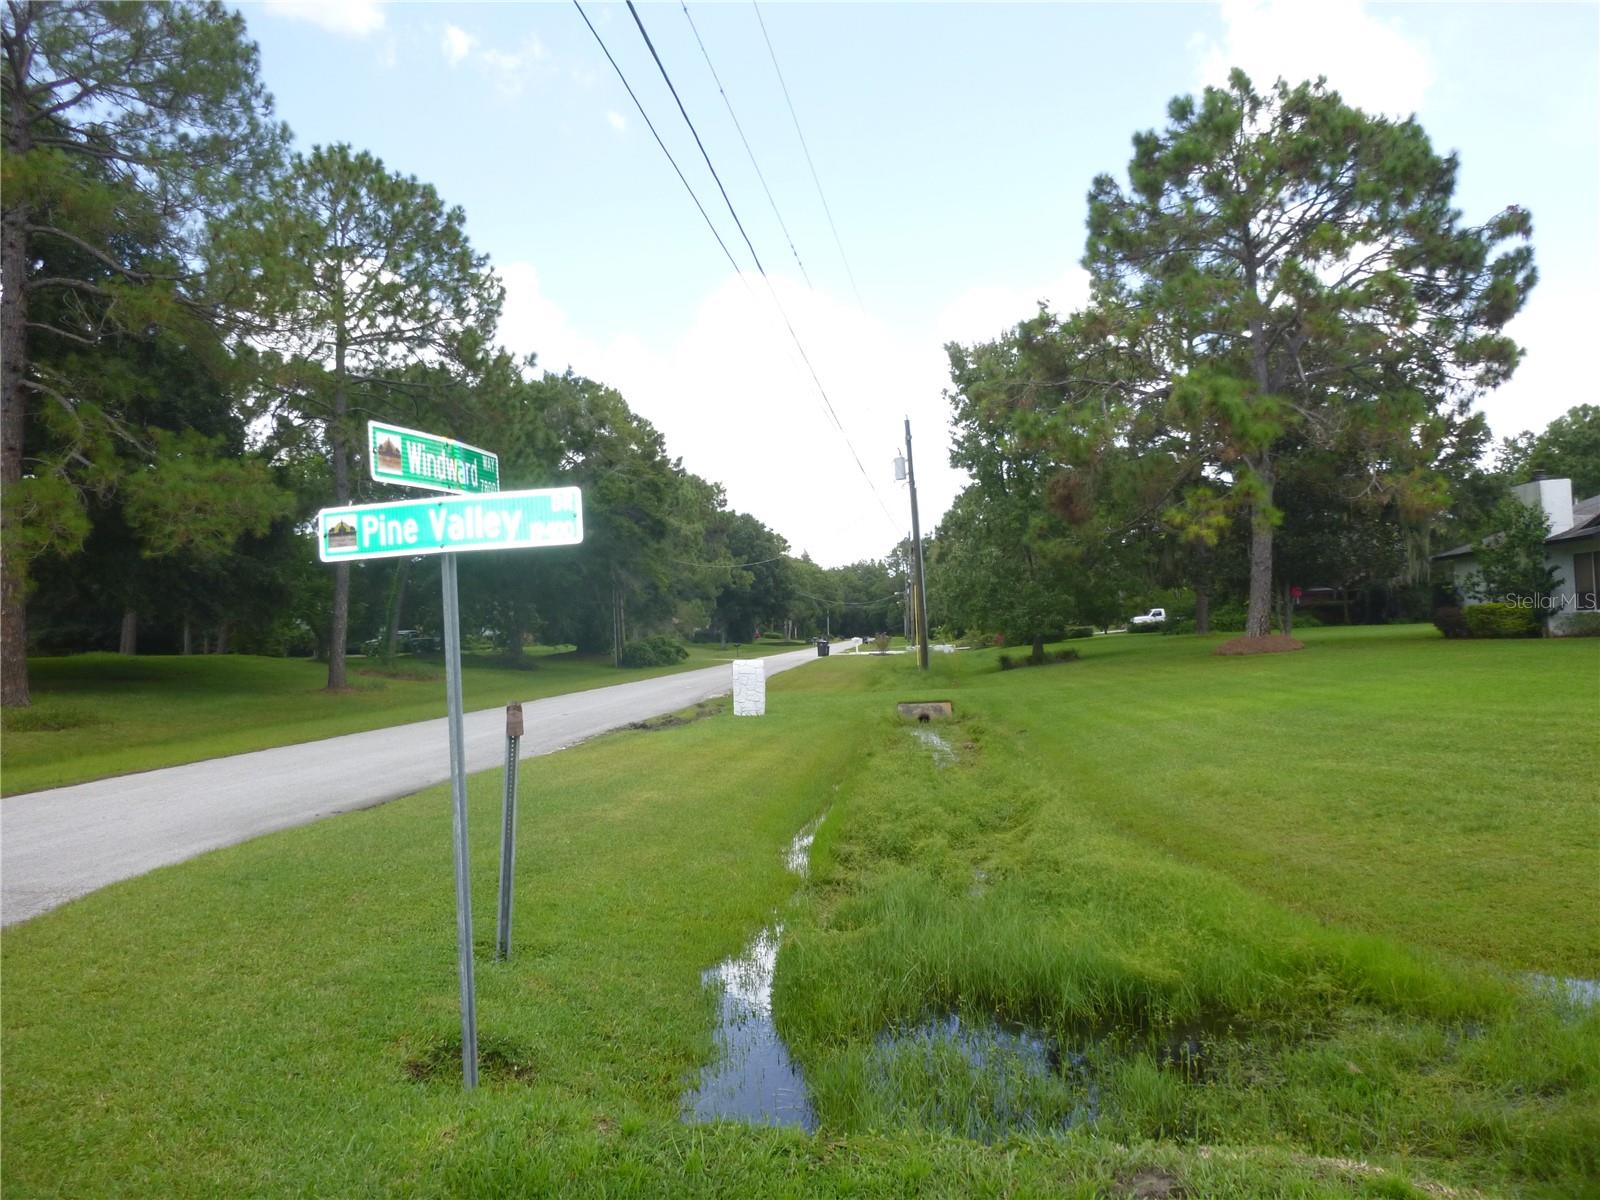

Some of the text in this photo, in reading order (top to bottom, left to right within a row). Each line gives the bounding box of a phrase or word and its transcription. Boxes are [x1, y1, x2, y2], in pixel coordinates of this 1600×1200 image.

[406, 440, 478, 487] Windward
[482, 455, 496, 472] WAY
[361, 514, 419, 548] Pine
[428, 505, 523, 543] Valley
